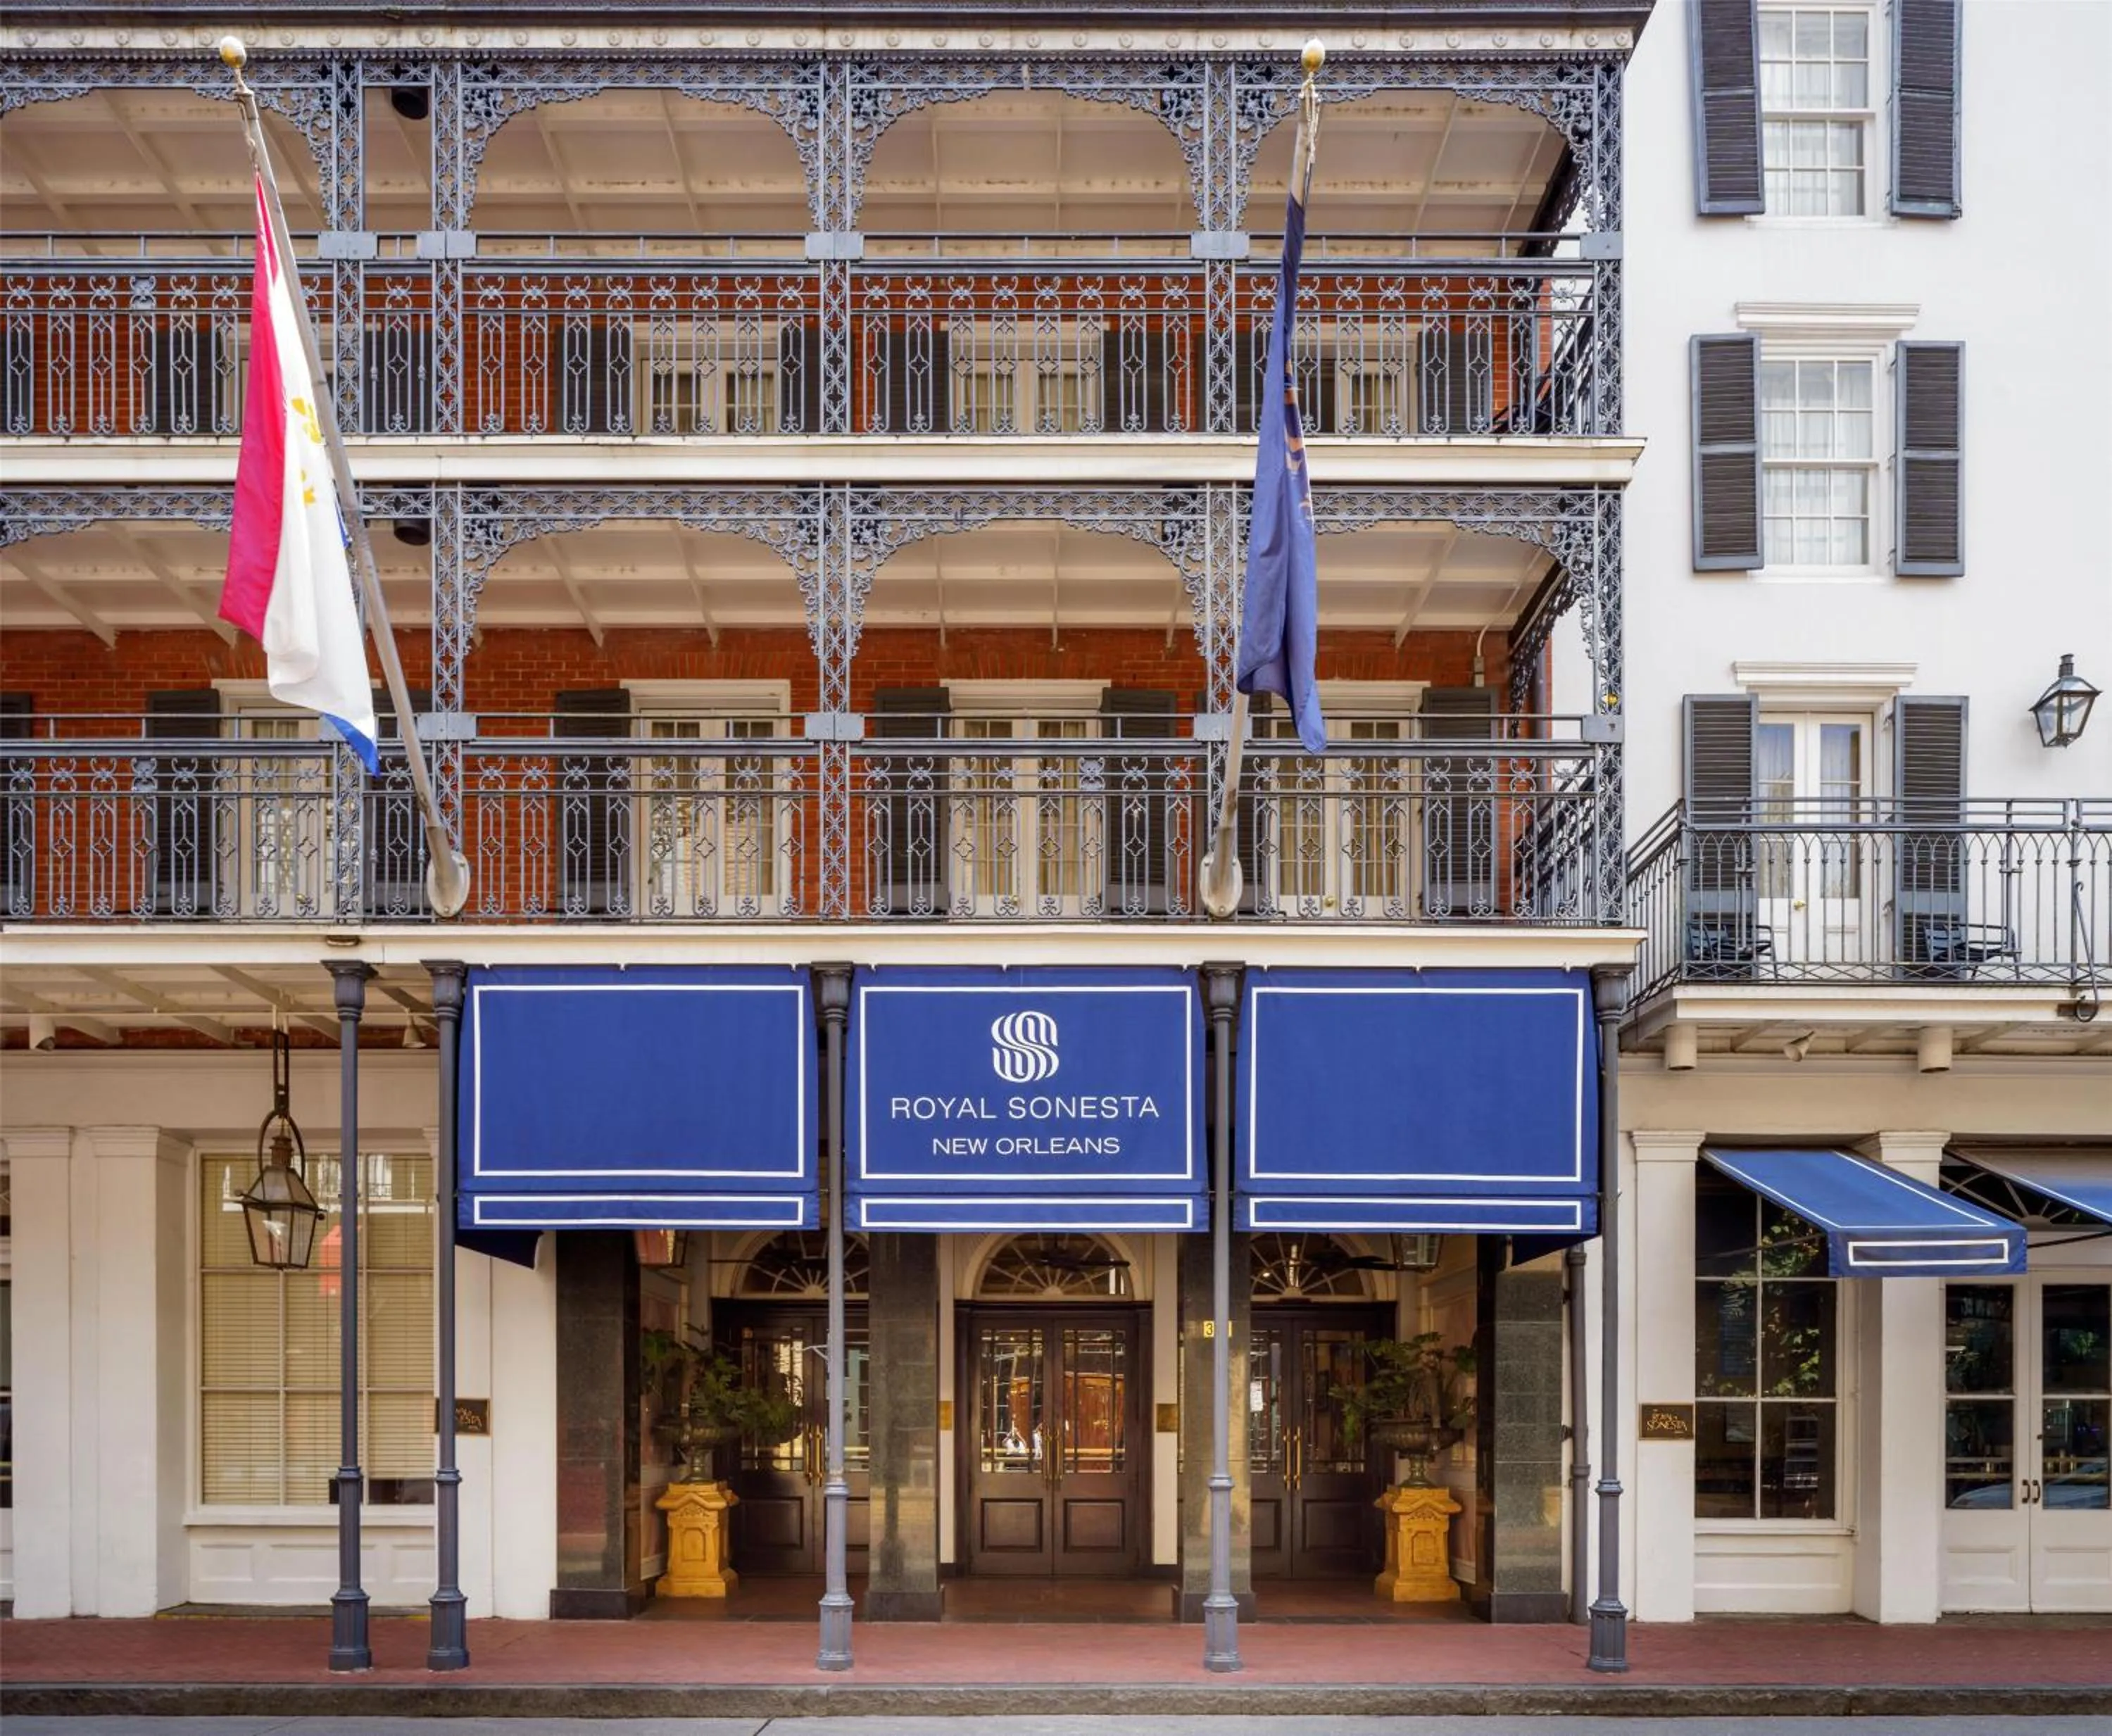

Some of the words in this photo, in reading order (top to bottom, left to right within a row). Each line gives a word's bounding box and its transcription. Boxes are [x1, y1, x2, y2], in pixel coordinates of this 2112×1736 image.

[891, 1096, 998, 1119] ROYAL
[1007, 1095, 1160, 1119] SONESTA
[932, 1138, 988, 1155] NEW
[995, 1137, 1121, 1155] ORLEANS
